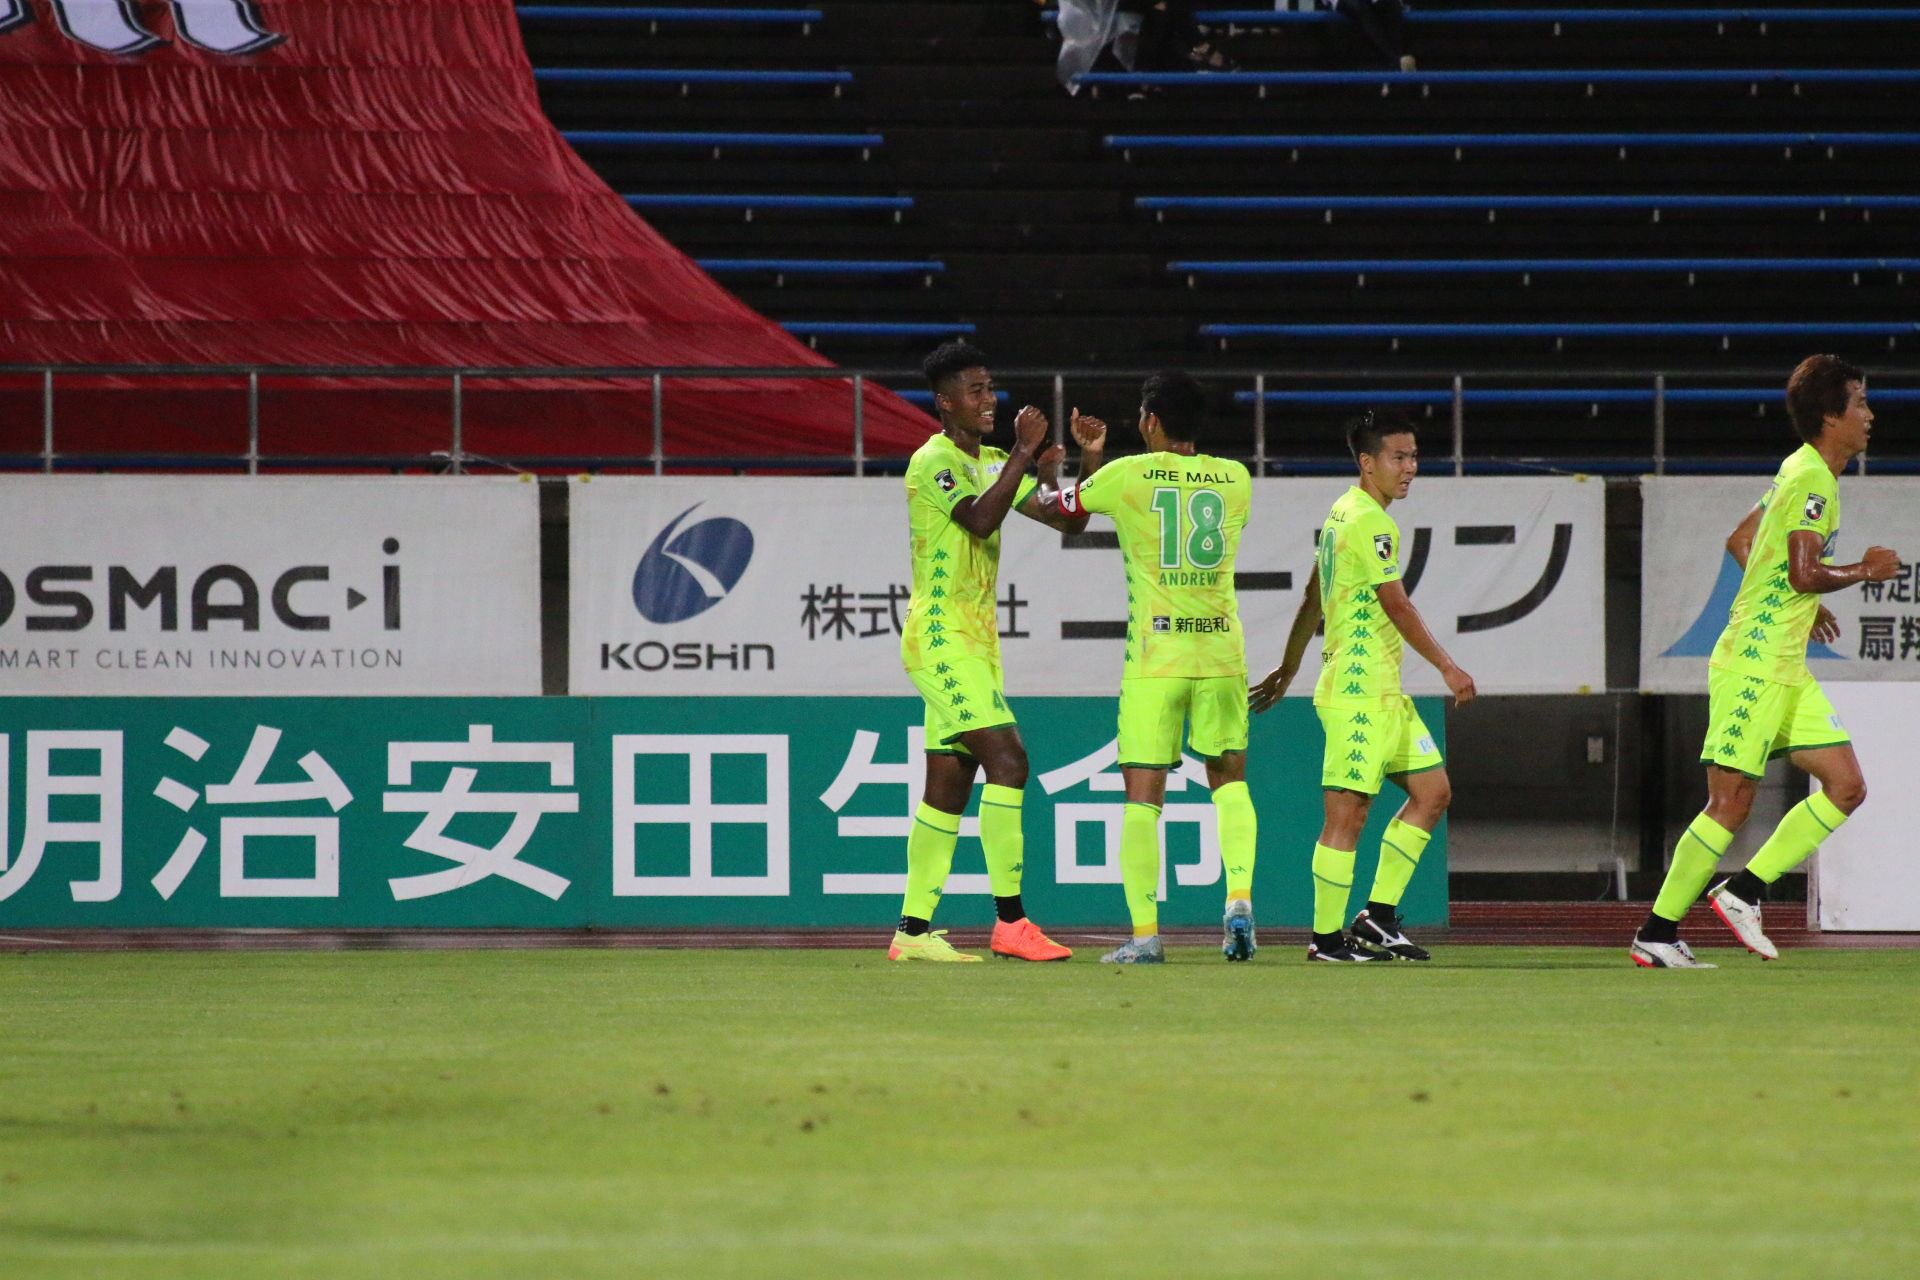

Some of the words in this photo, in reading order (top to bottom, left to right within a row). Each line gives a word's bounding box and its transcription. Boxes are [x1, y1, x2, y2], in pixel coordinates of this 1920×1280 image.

[1143, 469, 1179, 482] JRE
[1186, 471, 1236, 484] MALL
[1150, 486, 1226, 569] 18
[1159, 571, 1220, 586] ANDREW
[801, 584, 1030, 641] 株式社
[96, 649, 192, 669] CLEAN
[210, 649, 402, 669] INNOVATION
